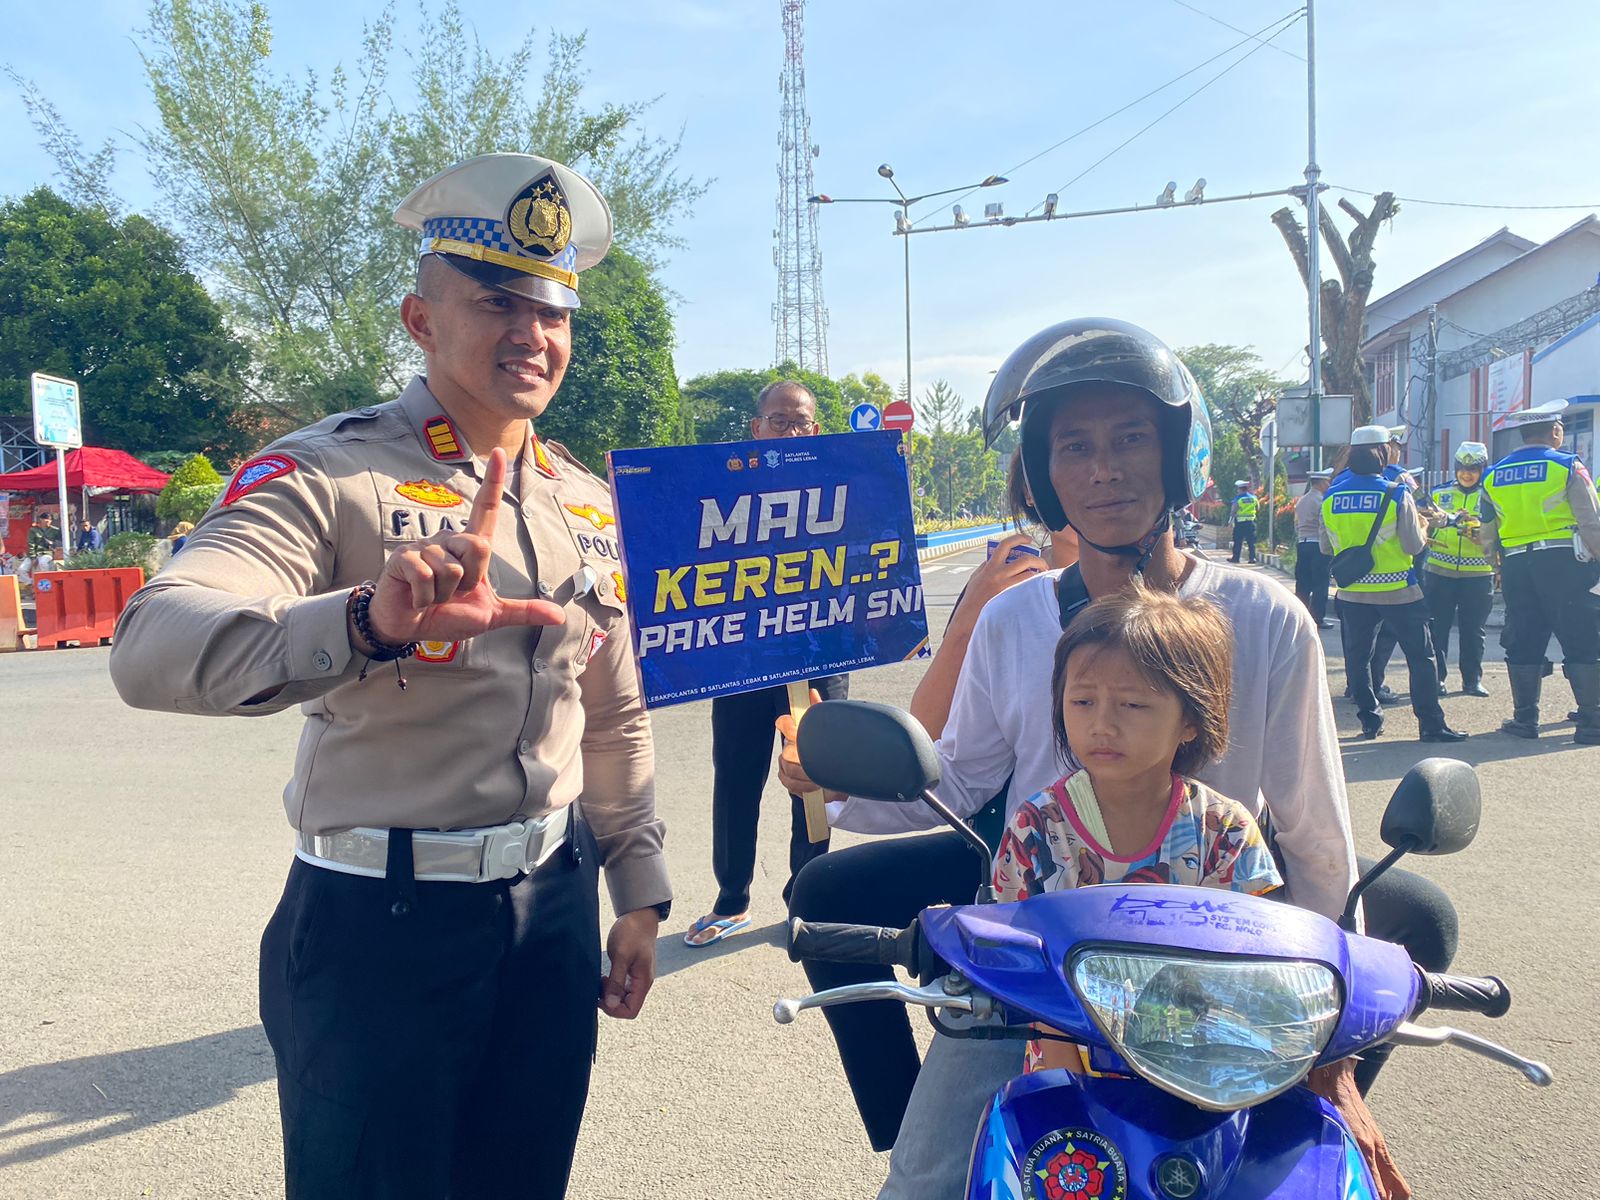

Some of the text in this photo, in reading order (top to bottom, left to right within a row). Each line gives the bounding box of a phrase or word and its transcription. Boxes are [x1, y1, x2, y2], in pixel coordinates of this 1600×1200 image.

[1495, 463, 1544, 483] POLISI
[391, 509, 469, 536] FIA
[698, 484, 848, 549] MAU
[1333, 494, 1378, 510] POLISI
[638, 584, 924, 658] PAKE HELM SNI
[1023, 1133, 1064, 1192] SATRIA BUANA
[1075, 1130, 1126, 1182] SATRIA BUANA
